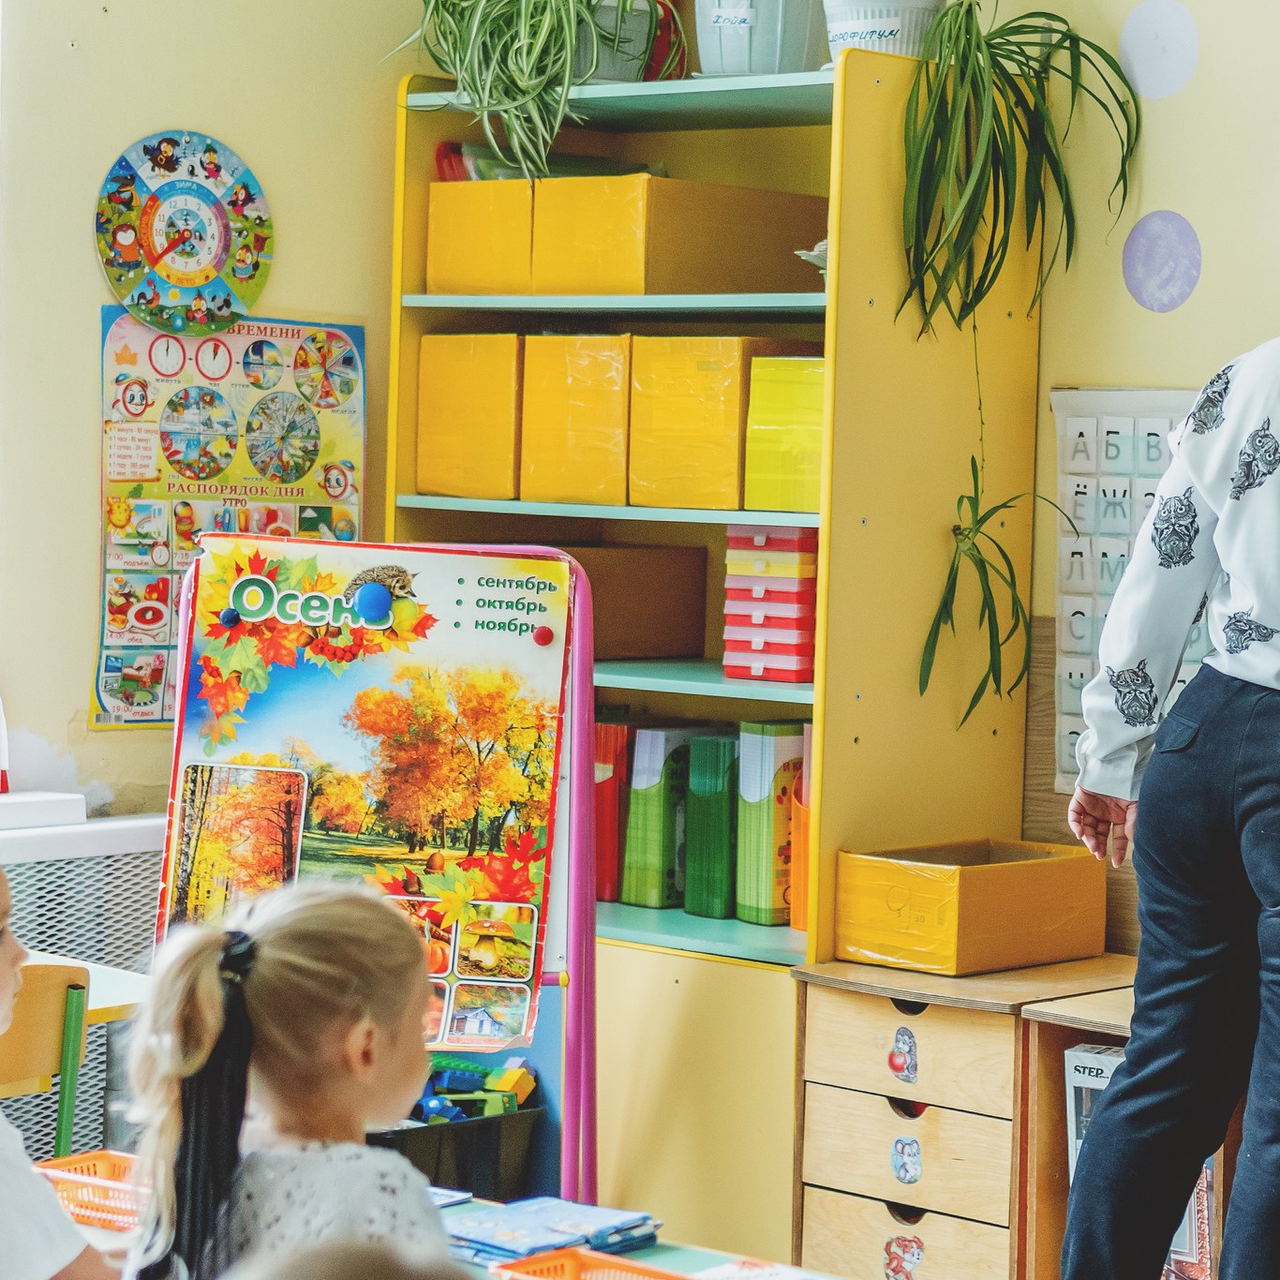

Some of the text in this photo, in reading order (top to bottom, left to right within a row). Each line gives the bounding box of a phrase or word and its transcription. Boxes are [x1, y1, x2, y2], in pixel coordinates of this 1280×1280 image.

[1071, 431, 1091, 461] А
[1105, 430, 1121, 461] Б
[1146, 432, 1163, 462] В
[166, 482, 305, 498] РАСПОРЯДОК ДНЯ
[222, 498, 247, 508] УТРО
[1073, 483, 1088, 520] Ё
[1102, 489, 1127, 519] Ж
[1066, 551, 1085, 581] Л
[1100, 551, 1126, 583] М
[477, 576, 558, 594] сентябрь
[230, 574, 393, 630] Осен
[475, 597, 548, 615] октябрь
[1069, 610, 1086, 640] С
